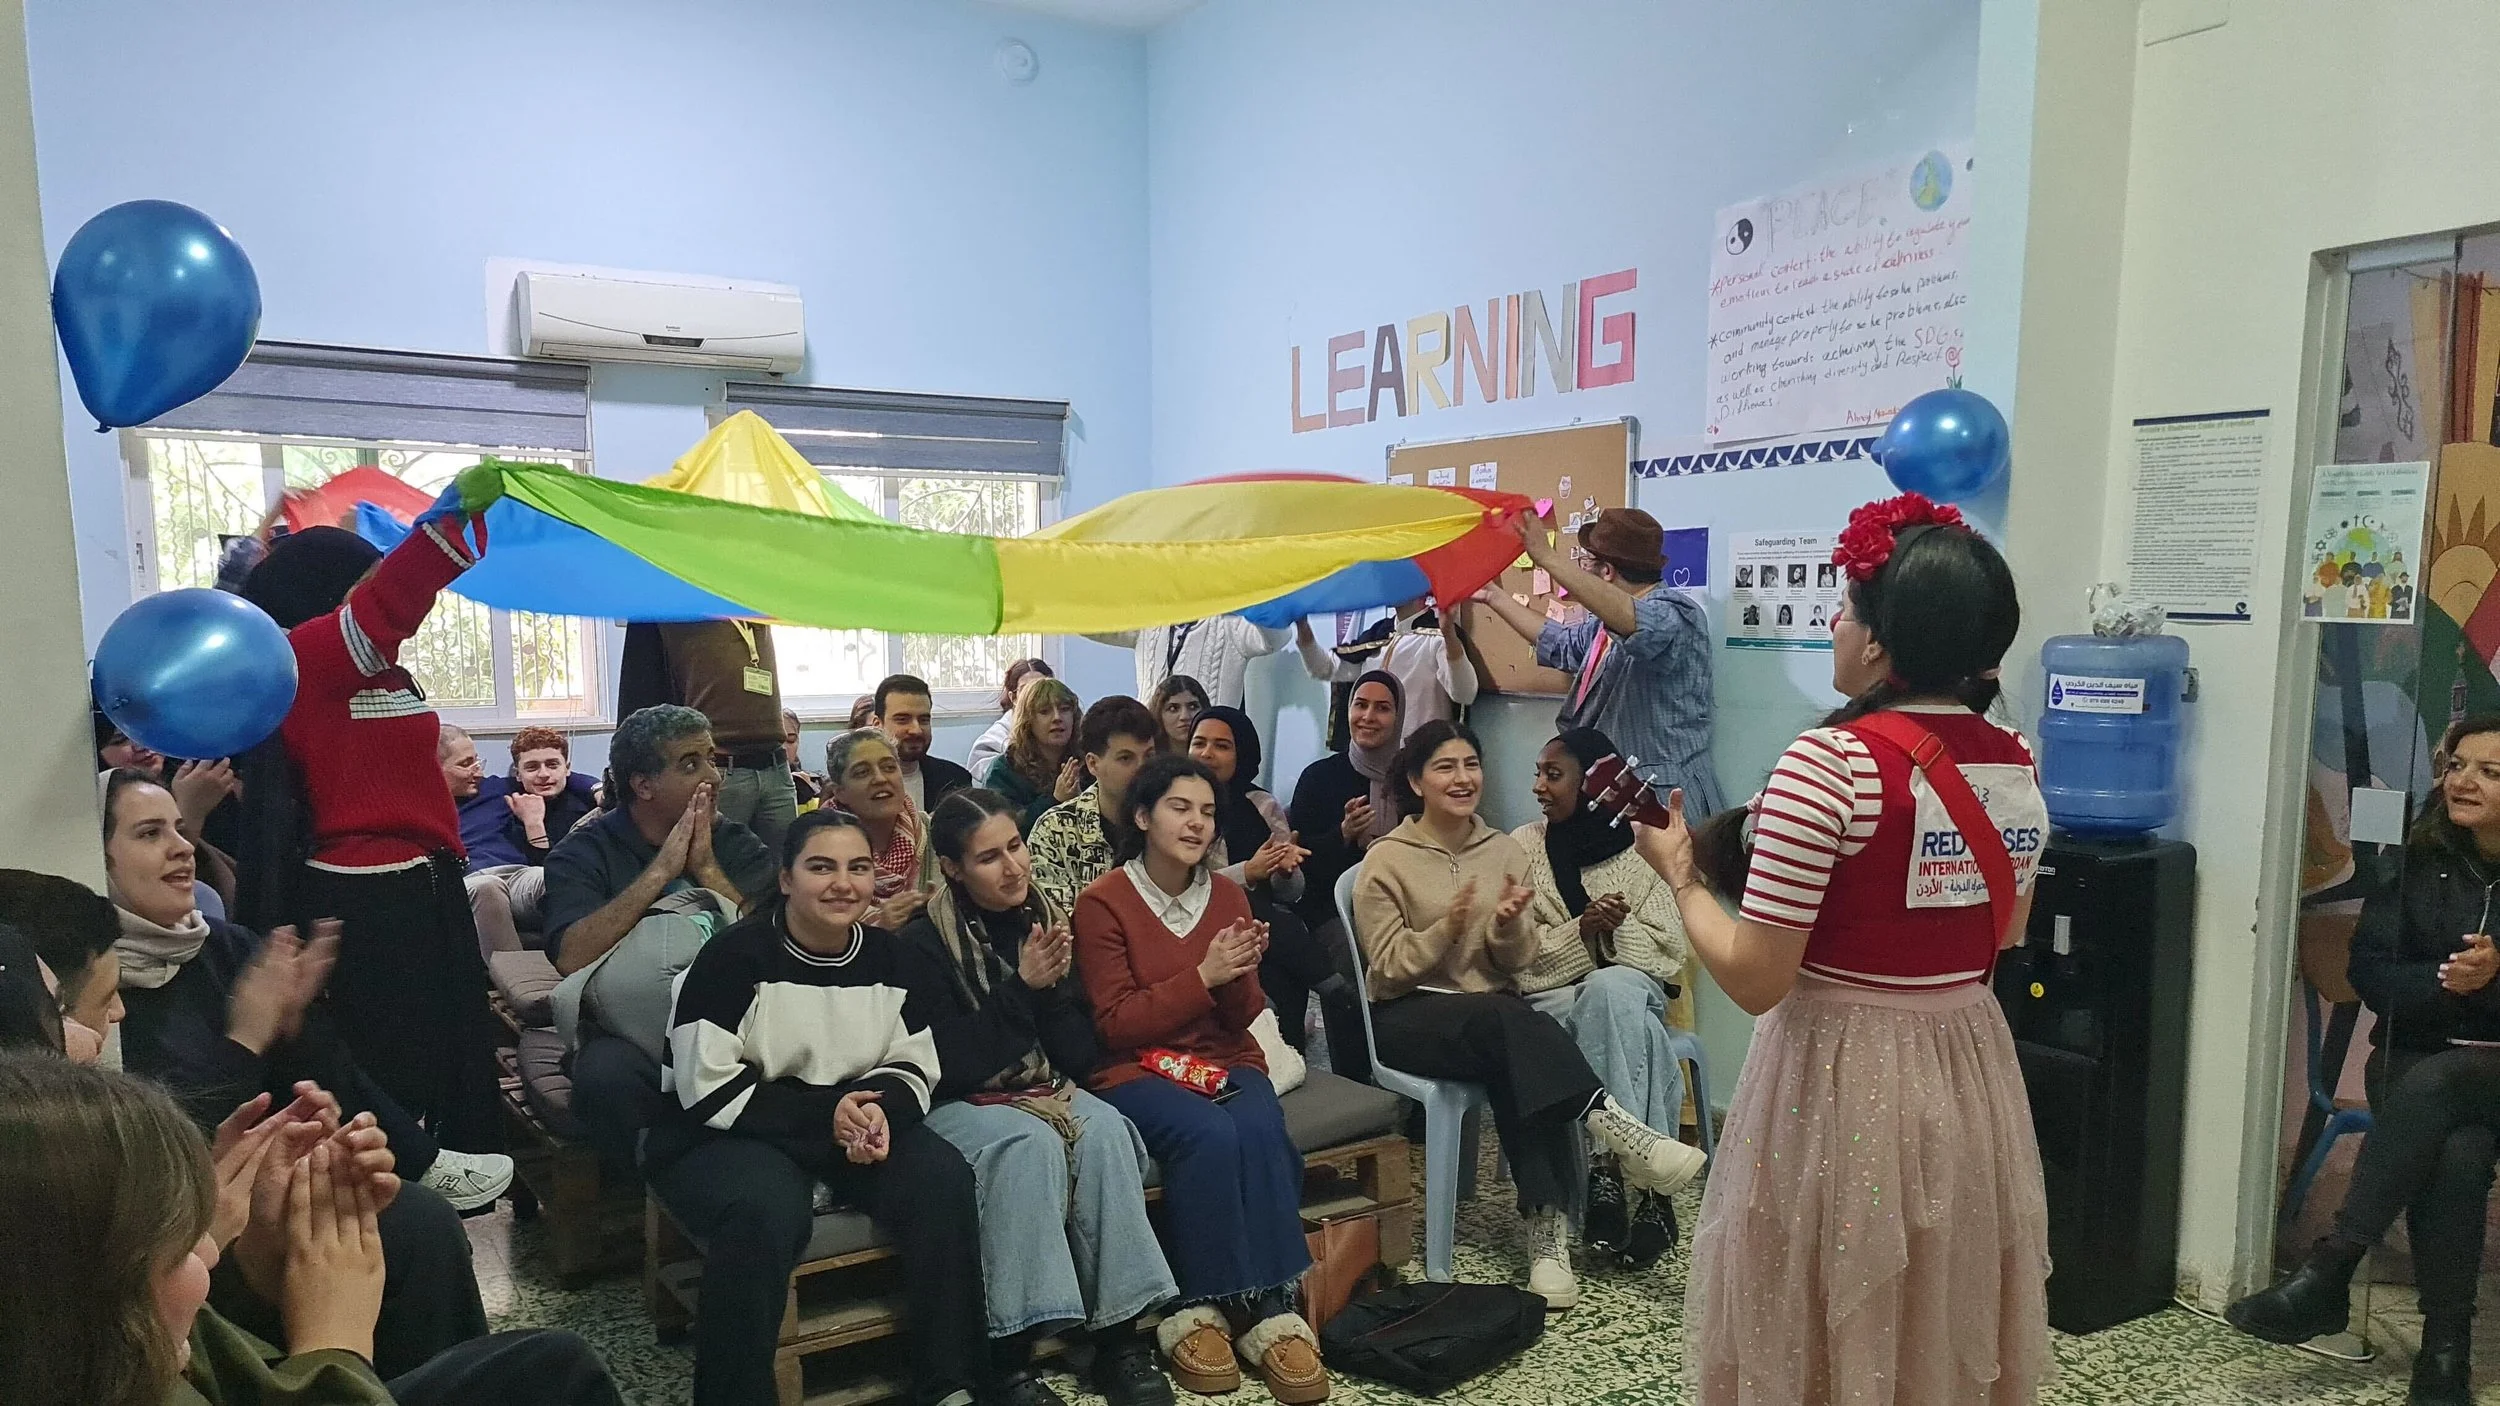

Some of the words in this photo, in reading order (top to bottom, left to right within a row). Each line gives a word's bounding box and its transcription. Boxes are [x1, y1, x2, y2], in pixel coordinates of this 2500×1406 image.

[1291, 268, 1638, 434] LEARNING
[1720, 362, 1767, 384] working
[1885, 334, 1906, 351] the
[1723, 341, 1744, 364] and
[1716, 393, 1729, 404] as
[1732, 383, 1752, 400] well
[1754, 537, 1796, 548] Safeguarding
[1799, 536, 1818, 545] Team
[1921, 831, 1967, 857] RED
[2002, 827, 2041, 852] SES
[1918, 859, 1982, 876] INTERNATIO
[1916, 878, 1942, 897] الأردن
